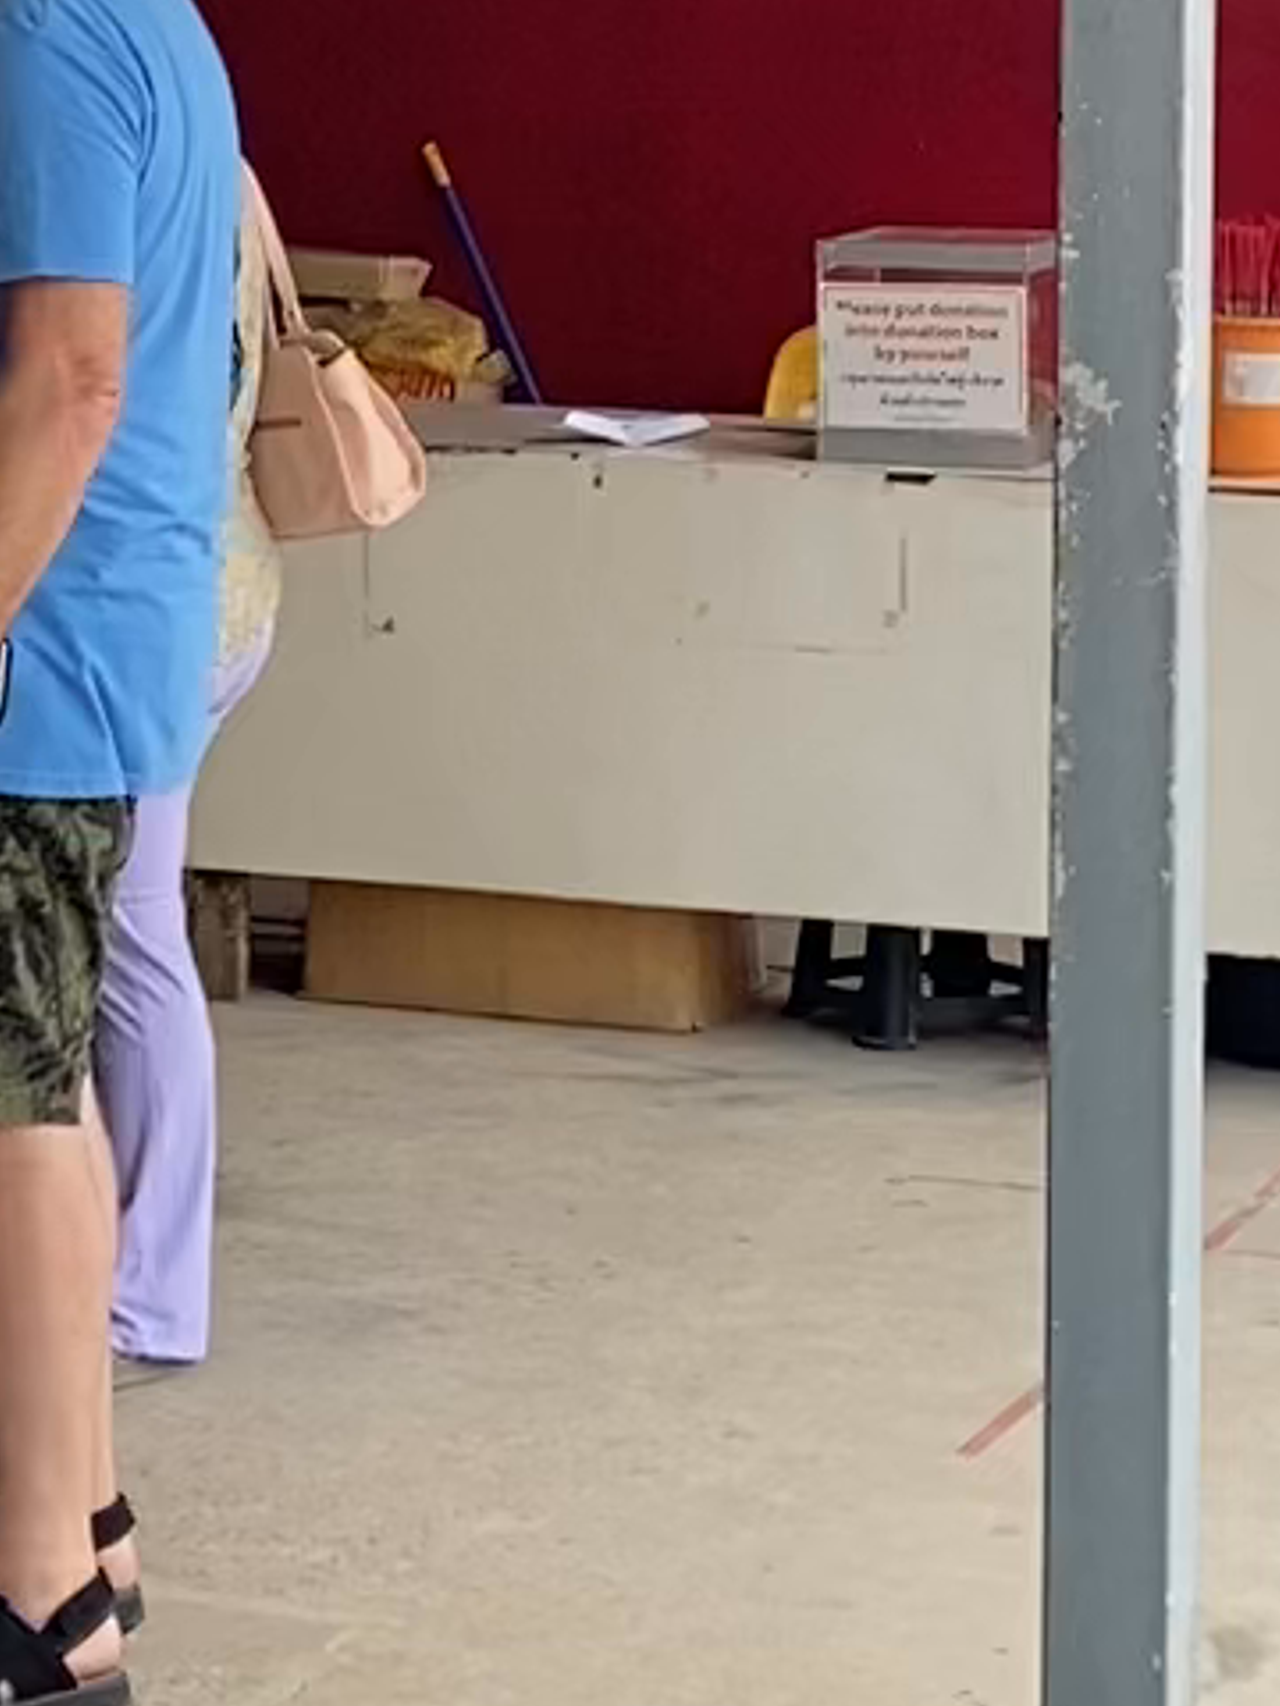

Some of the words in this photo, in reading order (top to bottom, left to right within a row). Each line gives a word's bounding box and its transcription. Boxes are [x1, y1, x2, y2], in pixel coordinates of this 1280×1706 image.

[894, 301, 924, 319] put
[929, 301, 1009, 318] donation
[883, 323, 963, 339] donation
[966, 324, 1000, 340] box
[874, 345, 896, 364] by
[899, 345, 970, 365] yourself
